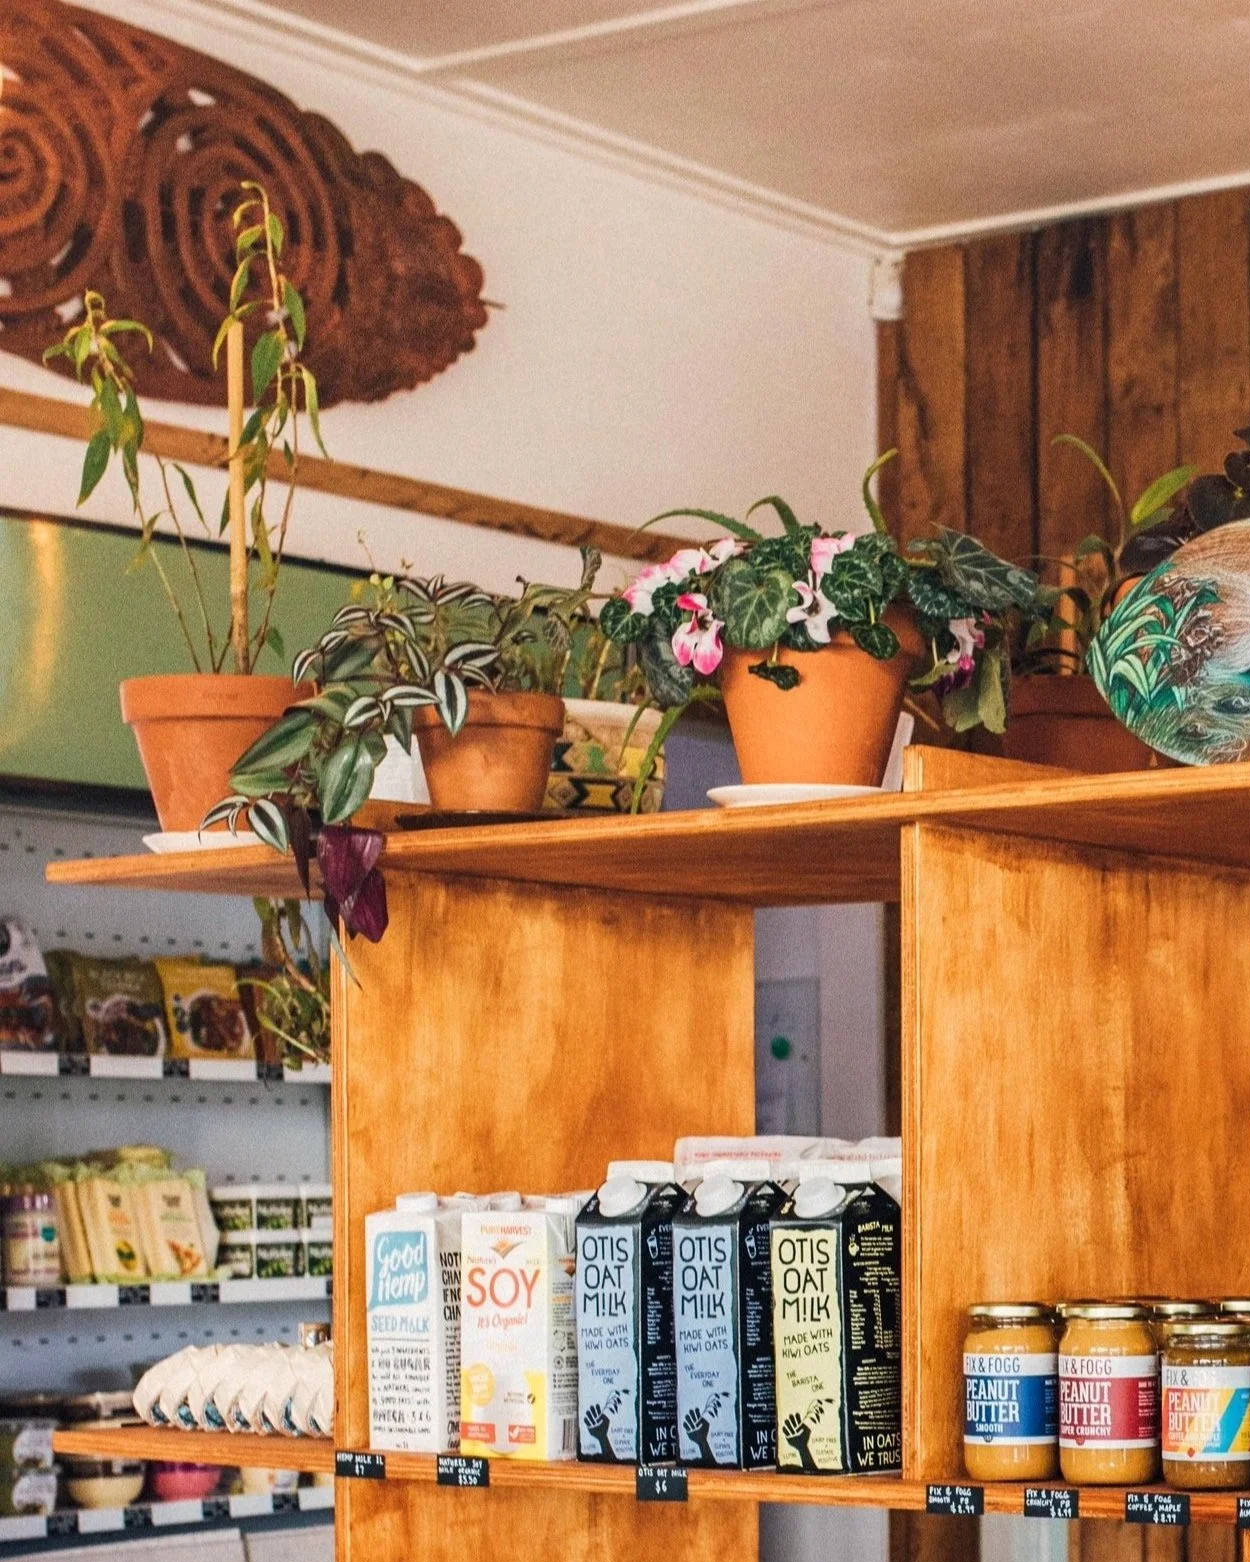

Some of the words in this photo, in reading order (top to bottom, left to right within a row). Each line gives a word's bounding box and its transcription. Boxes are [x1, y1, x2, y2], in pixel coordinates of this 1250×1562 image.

[377, 1233, 424, 1278] Good
[582, 1236, 628, 1263] OTIS
[680, 1236, 726, 1263] OTIS
[778, 1238, 830, 1265] OTIS
[377, 1268, 426, 1302] Hemp
[467, 1267, 540, 1308] SOY
[584, 1265, 625, 1291] OAT
[682, 1266, 722, 1292] OAT
[783, 1268, 828, 1294] OAT
[782, 1347, 802, 1359] KIWI
[804, 1343, 830, 1355] OATS
[966, 1357, 976, 1372] FIX
[979, 1358, 985, 1371] &
[988, 1358, 1020, 1373] FOGG
[967, 1379, 1020, 1400] PEANUT
[1060, 1381, 1112, 1402] PEANUT
[1168, 1391, 1221, 1410] PEANUT
[967, 1401, 1020, 1422] BUTTER
[1060, 1404, 1112, 1425] BUTTER
[1168, 1412, 1221, 1431] BUTTER
[976, 1423, 1003, 1433] SMOOTH
[638, 1468, 653, 1476] OTIS
[657, 1469, 668, 1477] OAT
[671, 1469, 687, 1478] MILK
[655, 1480, 667, 1493] $6
[1127, 1503, 1153, 1511] COFFEE
[1159, 1504, 1181, 1512] MAPLE
